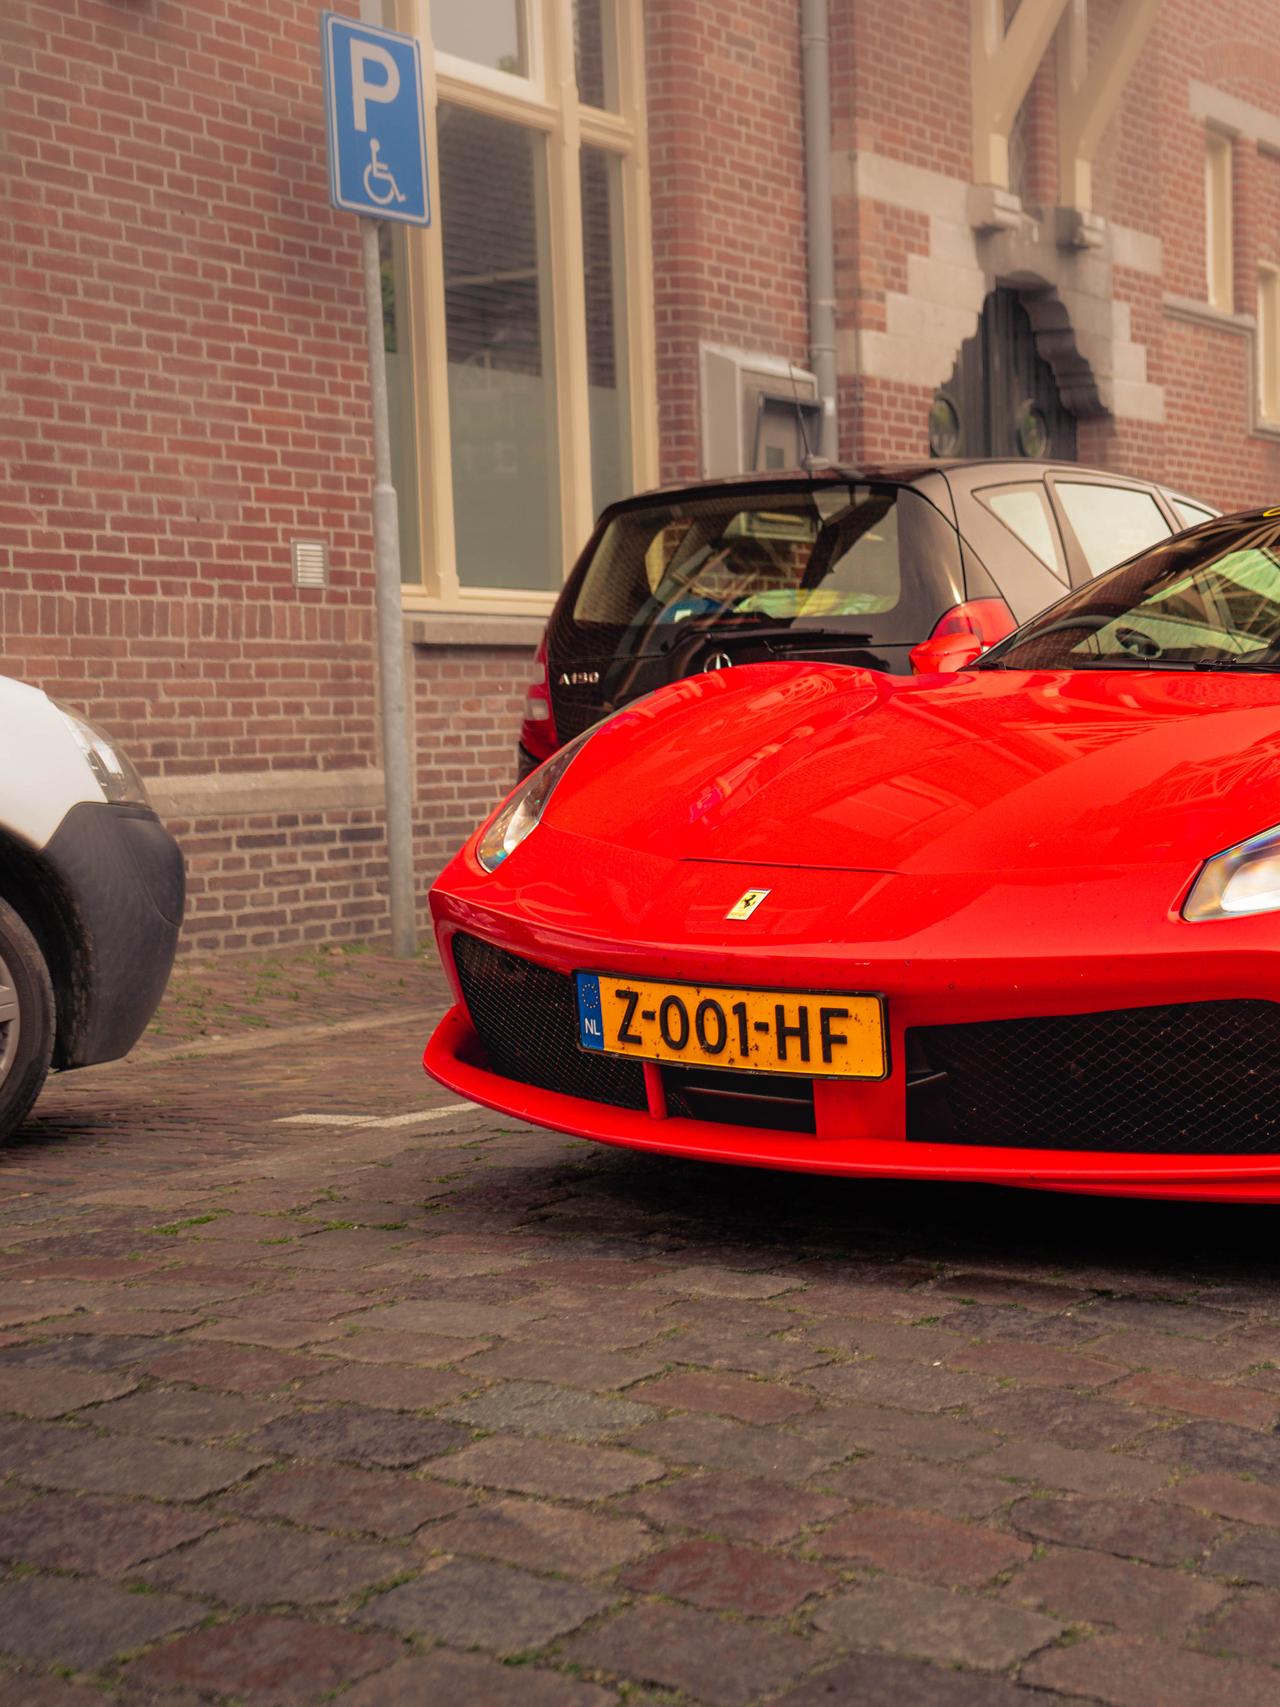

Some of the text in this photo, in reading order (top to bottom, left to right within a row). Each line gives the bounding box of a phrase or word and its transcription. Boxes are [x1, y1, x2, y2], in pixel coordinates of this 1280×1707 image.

[350, 37, 401, 132] P
[584, 1018, 601, 1036] NL
[615, 989, 849, 1063] Z-001-HF
